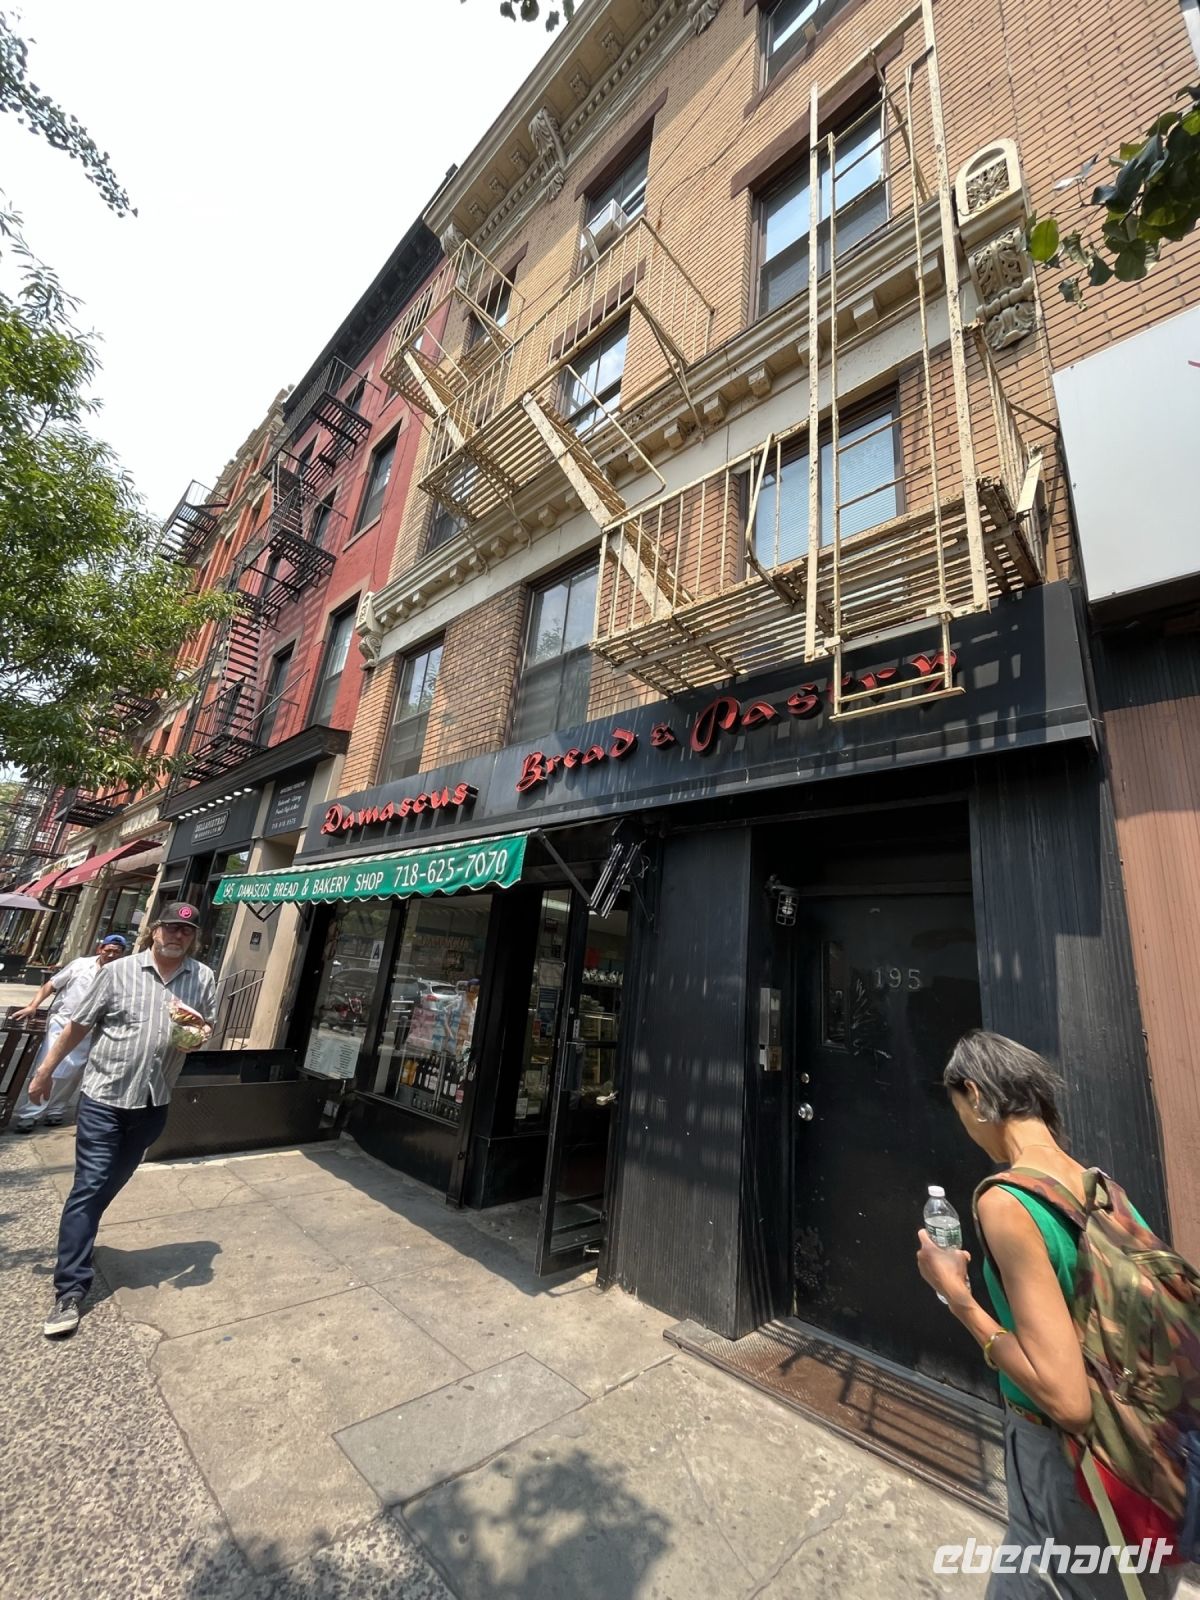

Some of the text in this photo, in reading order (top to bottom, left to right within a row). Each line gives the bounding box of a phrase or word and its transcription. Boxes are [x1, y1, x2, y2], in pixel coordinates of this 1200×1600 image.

[320, 782, 477, 835] Damascus
[515, 727, 640, 792] Bread
[650, 723, 676, 747] &
[223, 849, 508, 898] 195 DAMASCUS BREAD & BAKERY SHOP 718-625-7070
[874, 967, 921, 990] 195
